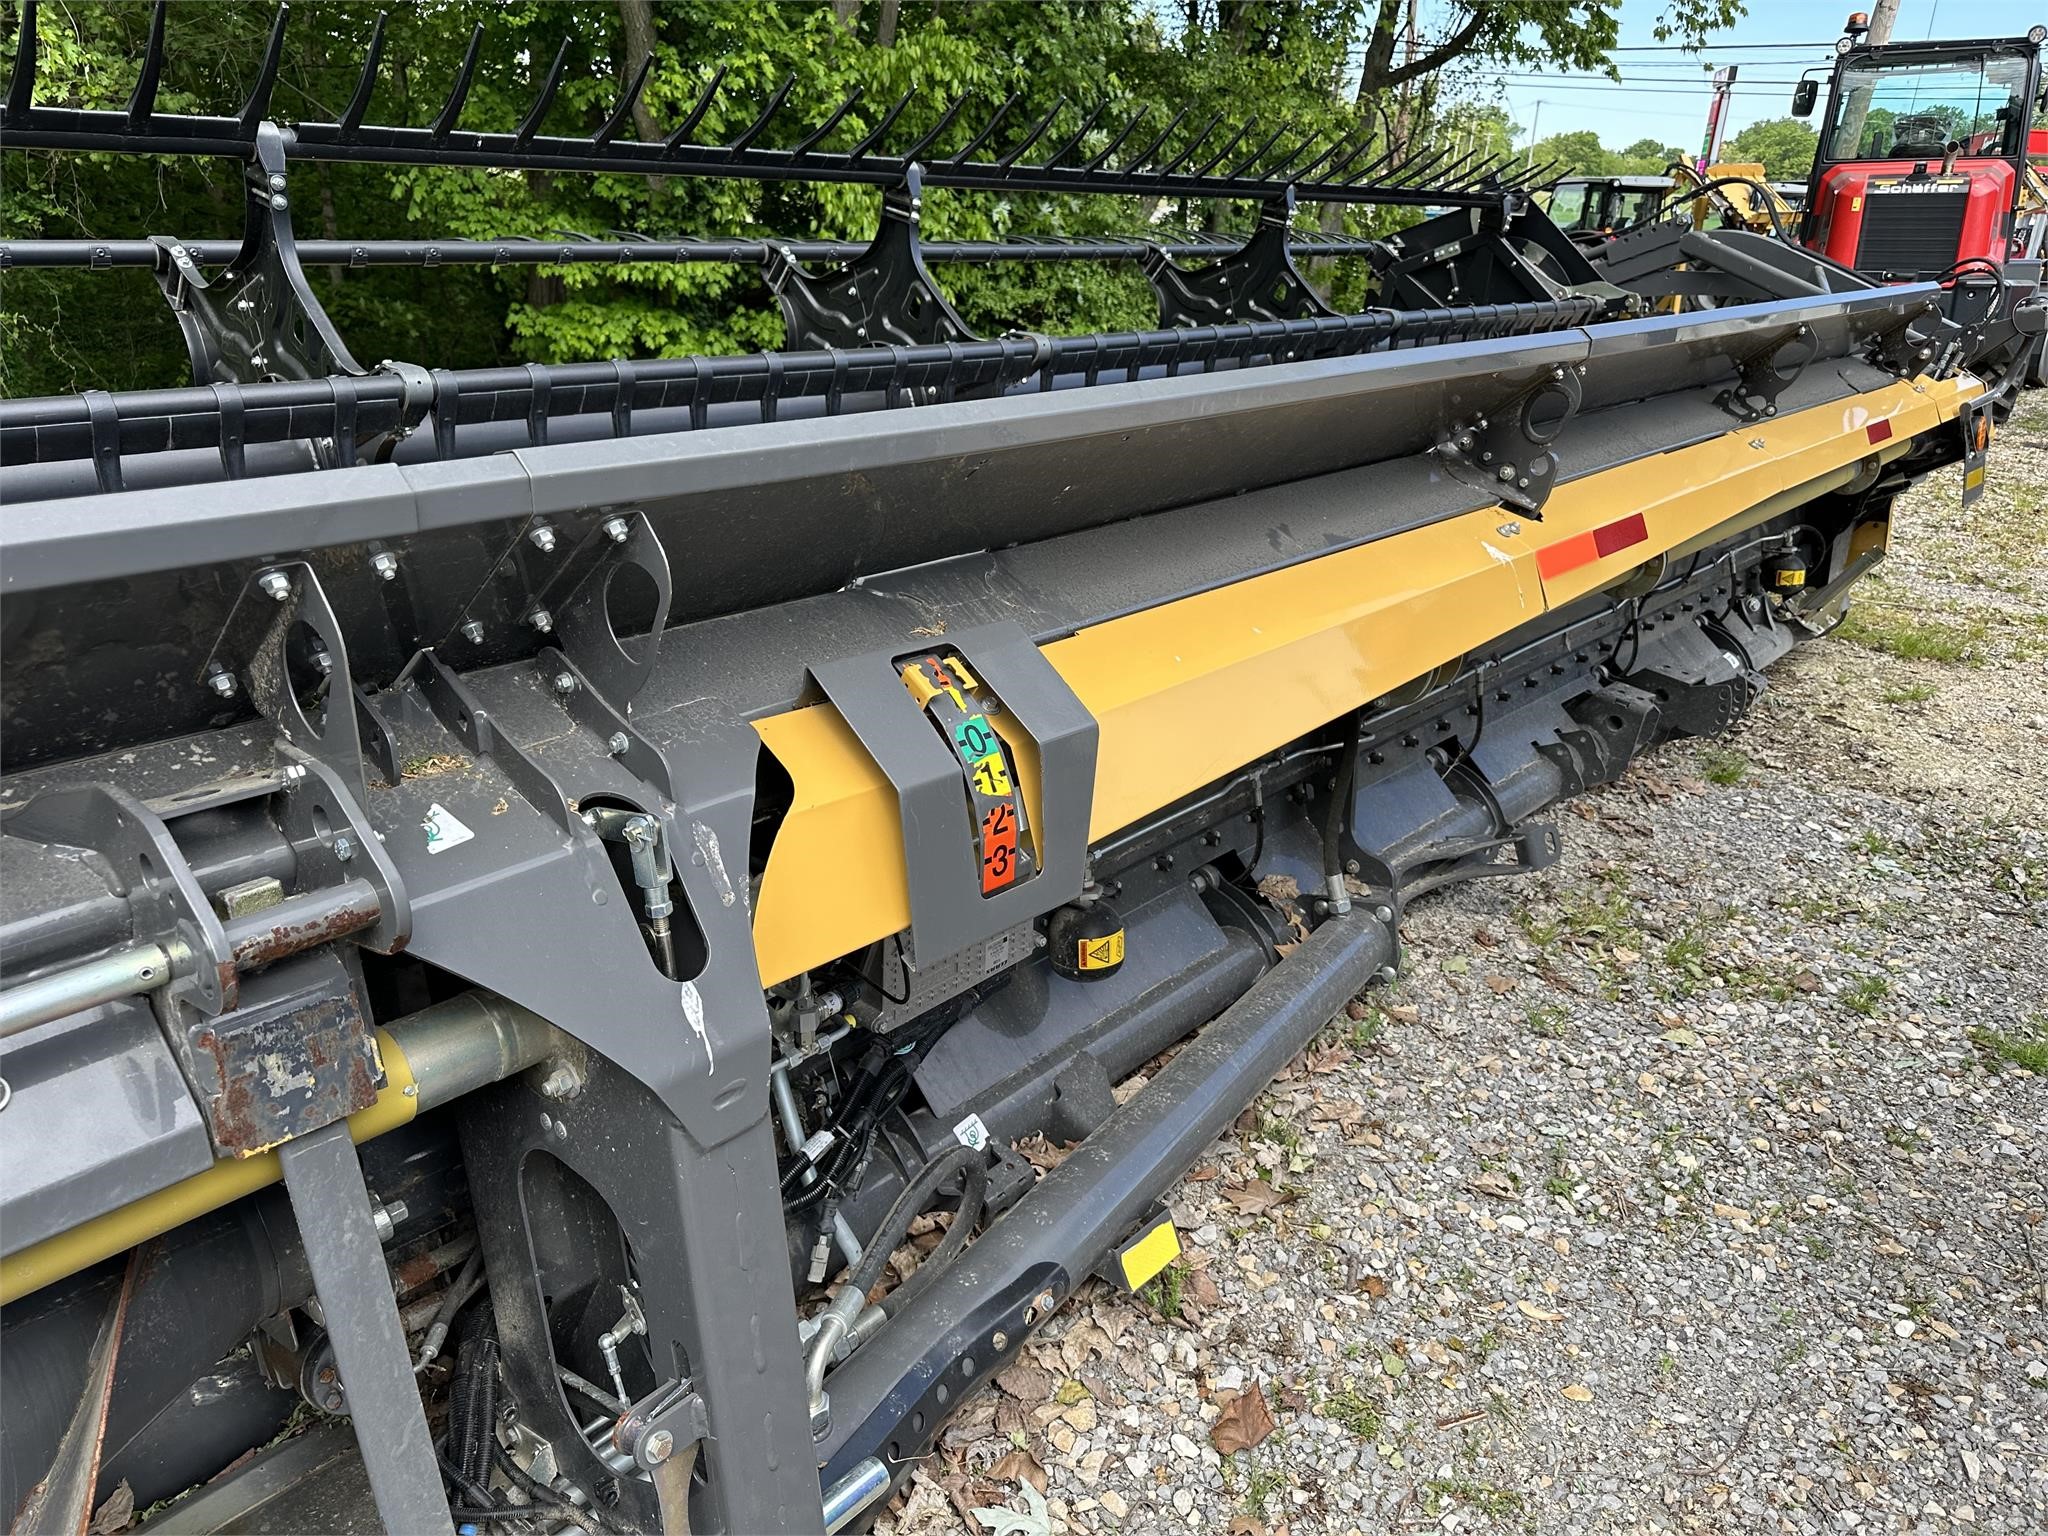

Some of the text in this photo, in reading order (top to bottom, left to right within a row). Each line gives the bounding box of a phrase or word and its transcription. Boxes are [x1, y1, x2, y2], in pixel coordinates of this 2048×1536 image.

[963, 724, 987, 757] 0
[980, 761, 997, 793] 1
[991, 803, 1008, 835] 2
[992, 844, 1008, 877] 3
